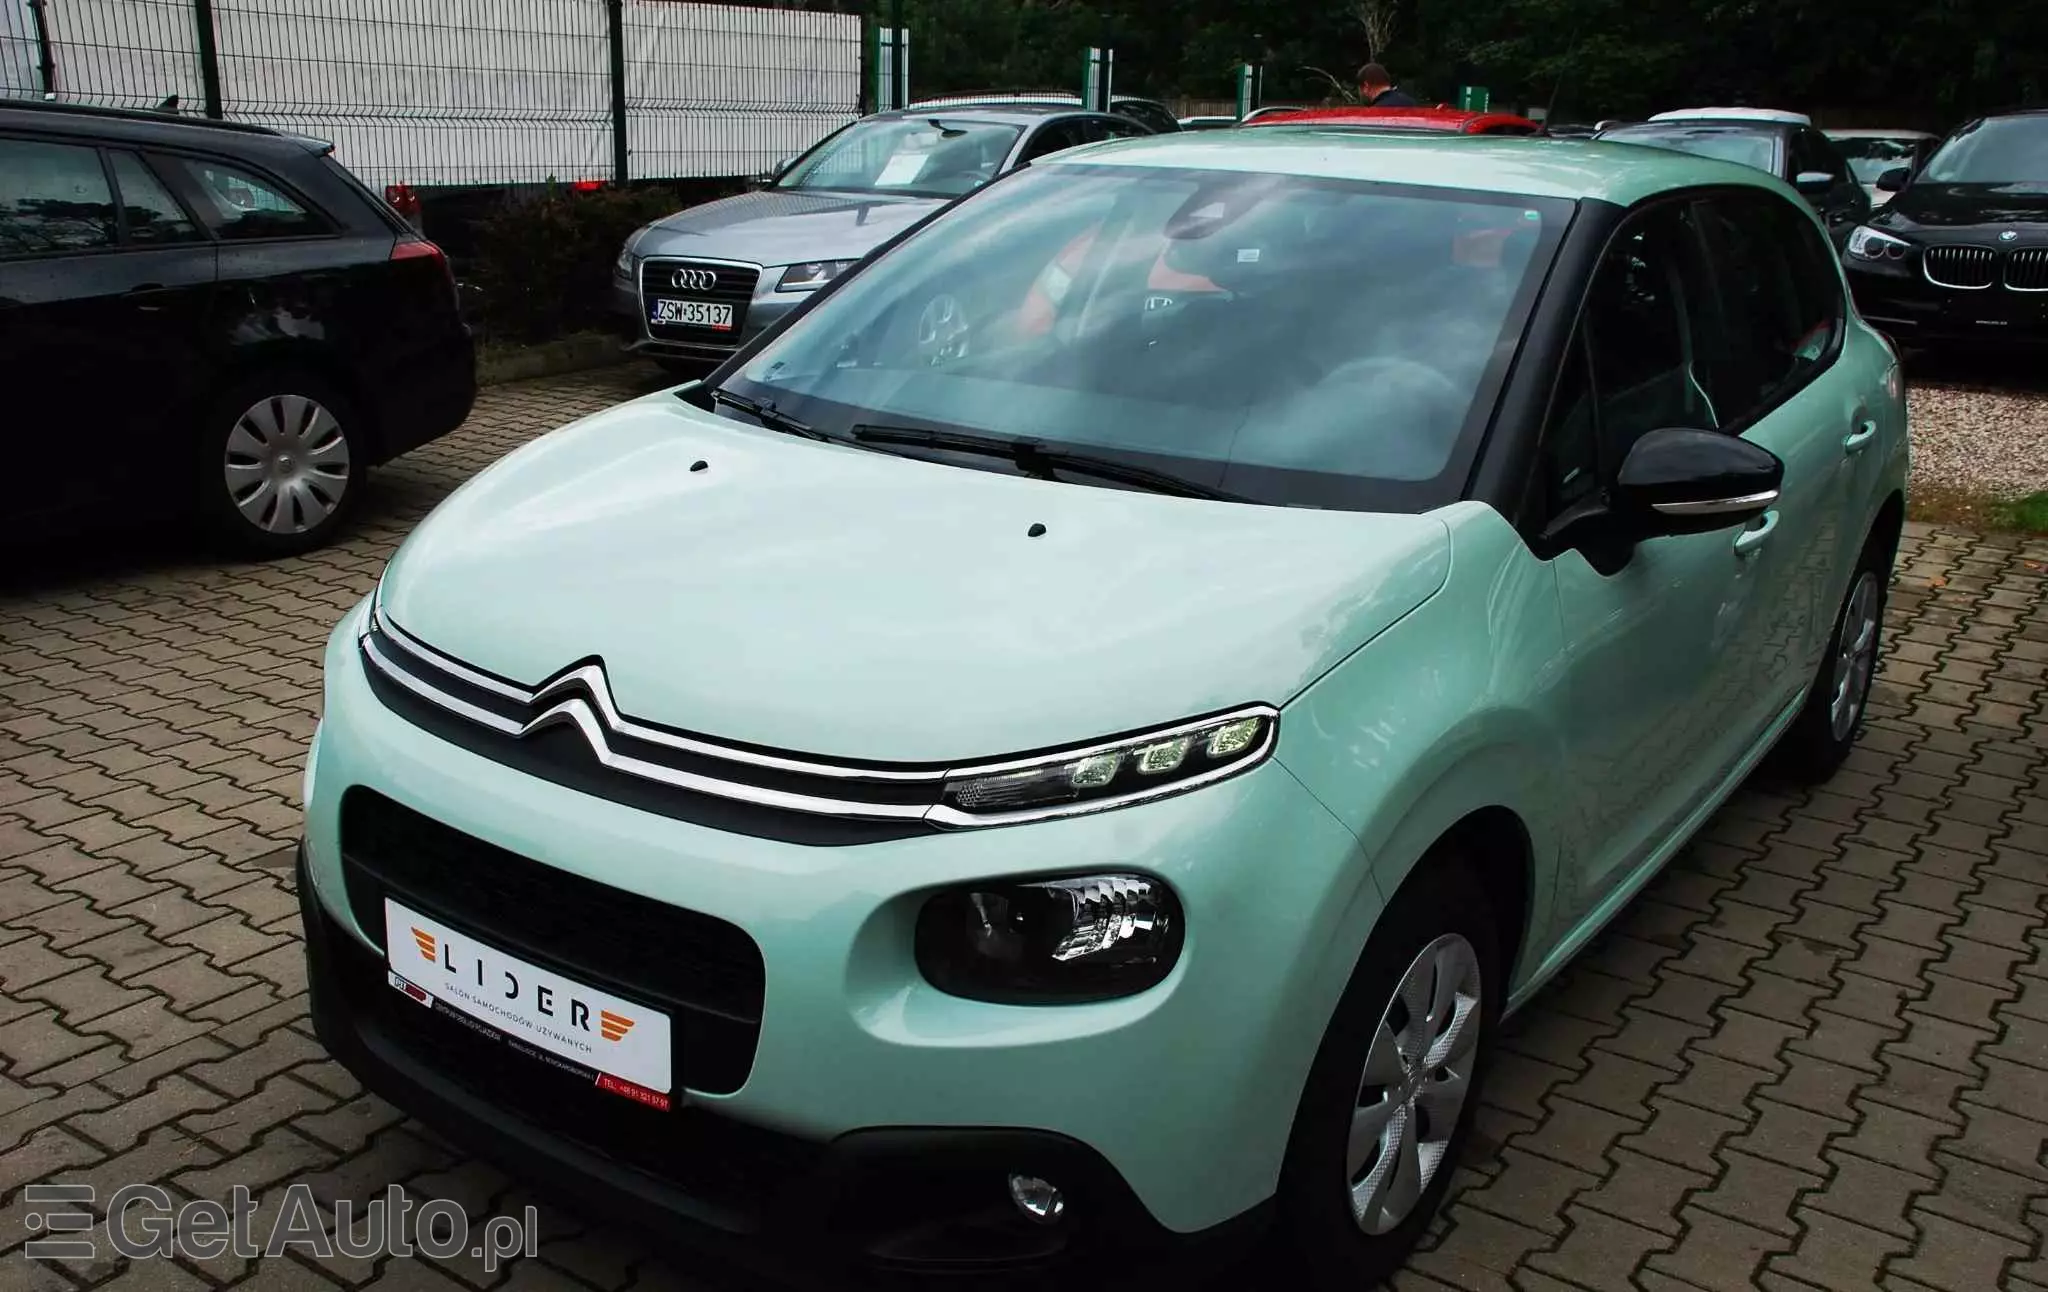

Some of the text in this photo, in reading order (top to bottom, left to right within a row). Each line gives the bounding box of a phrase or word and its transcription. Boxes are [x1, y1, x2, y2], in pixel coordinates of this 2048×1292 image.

[659, 300, 732, 325] ZSW 35137
[444, 943, 591, 1032] LIDER
[445, 982, 471, 1000] SALON
[472, 995, 534, 1030] SAMOCHODÓW
